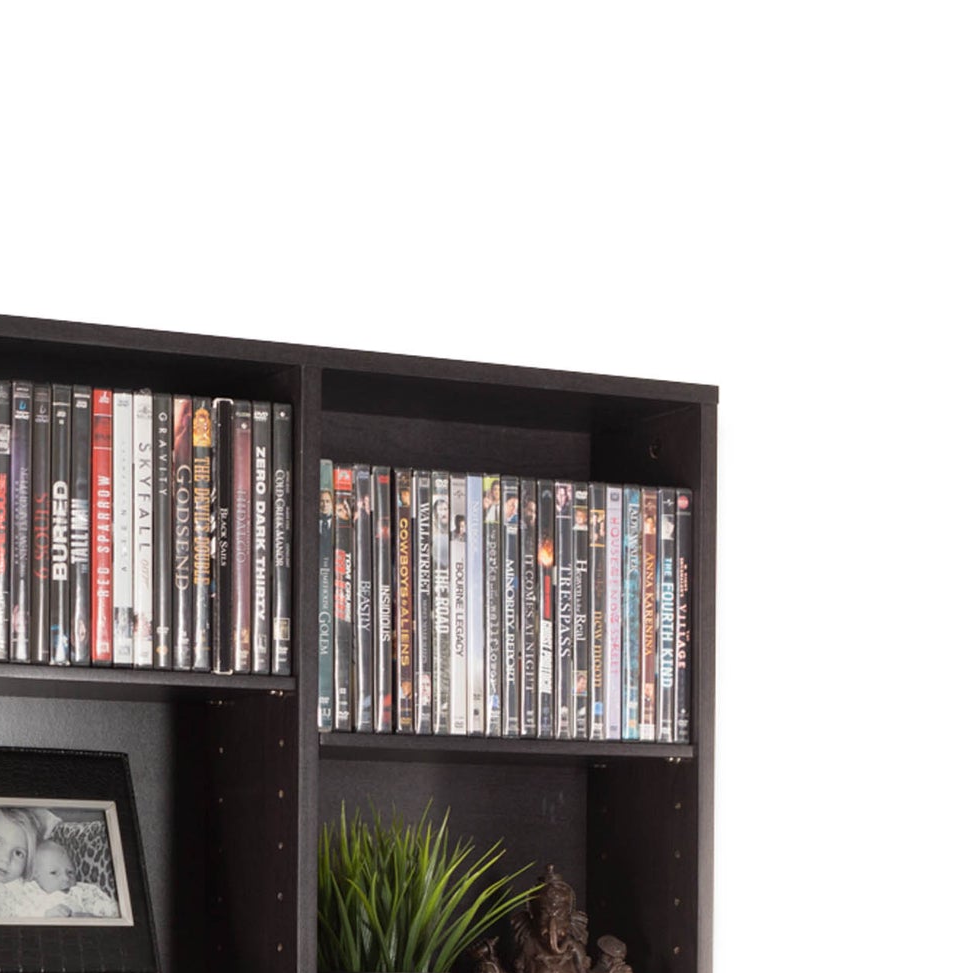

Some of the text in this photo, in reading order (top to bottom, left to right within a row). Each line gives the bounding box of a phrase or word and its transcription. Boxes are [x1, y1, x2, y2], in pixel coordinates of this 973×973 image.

[159, 412, 167, 495] GRAVITY
[34, 493, 49, 578] 6 SOULS
[52, 481, 67, 581] BURIED
[98, 475, 108, 597] RED SPARROW
[139, 443, 150, 552] SKYFALL
[176, 465, 191, 590] GODSEND
[194, 457, 210, 584] THE DEVIL'S DOUBLE
[236, 490, 245, 562] HIDALGO
[256, 446, 265, 620] ZERO DARK THIRTY
[275, 470, 285, 567] COLD CREEK MANOR
[419, 502, 429, 540] WALL
[71, 535, 88, 564] TALL
[400, 518, 408, 597] COWBOYS
[420, 542, 429, 595] STREET
[319, 612, 331, 654] GOLEM
[359, 581, 370, 631] BEASTLY
[381, 585, 390, 641] INSIDIOUS
[401, 607, 409, 666] ALIENS
[435, 569, 448, 633] THE ROAD
[455, 612, 463, 656] LEGACY
[489, 542, 499, 694] perks wallflower
[506, 559, 515, 684] MINORITY REPORT
[525, 555, 535, 693] IT COMES AT NIGHT
[560, 564, 571, 657] TRESPASS
[576, 614, 586, 641] Real
[645, 553, 655, 656] ANNA KARENINA
[662, 583, 673, 641] FOURTH
[678, 604, 686, 669] VILLAGE
[593, 611, 603, 687] new moon
[662, 648, 673, 687] KIND
